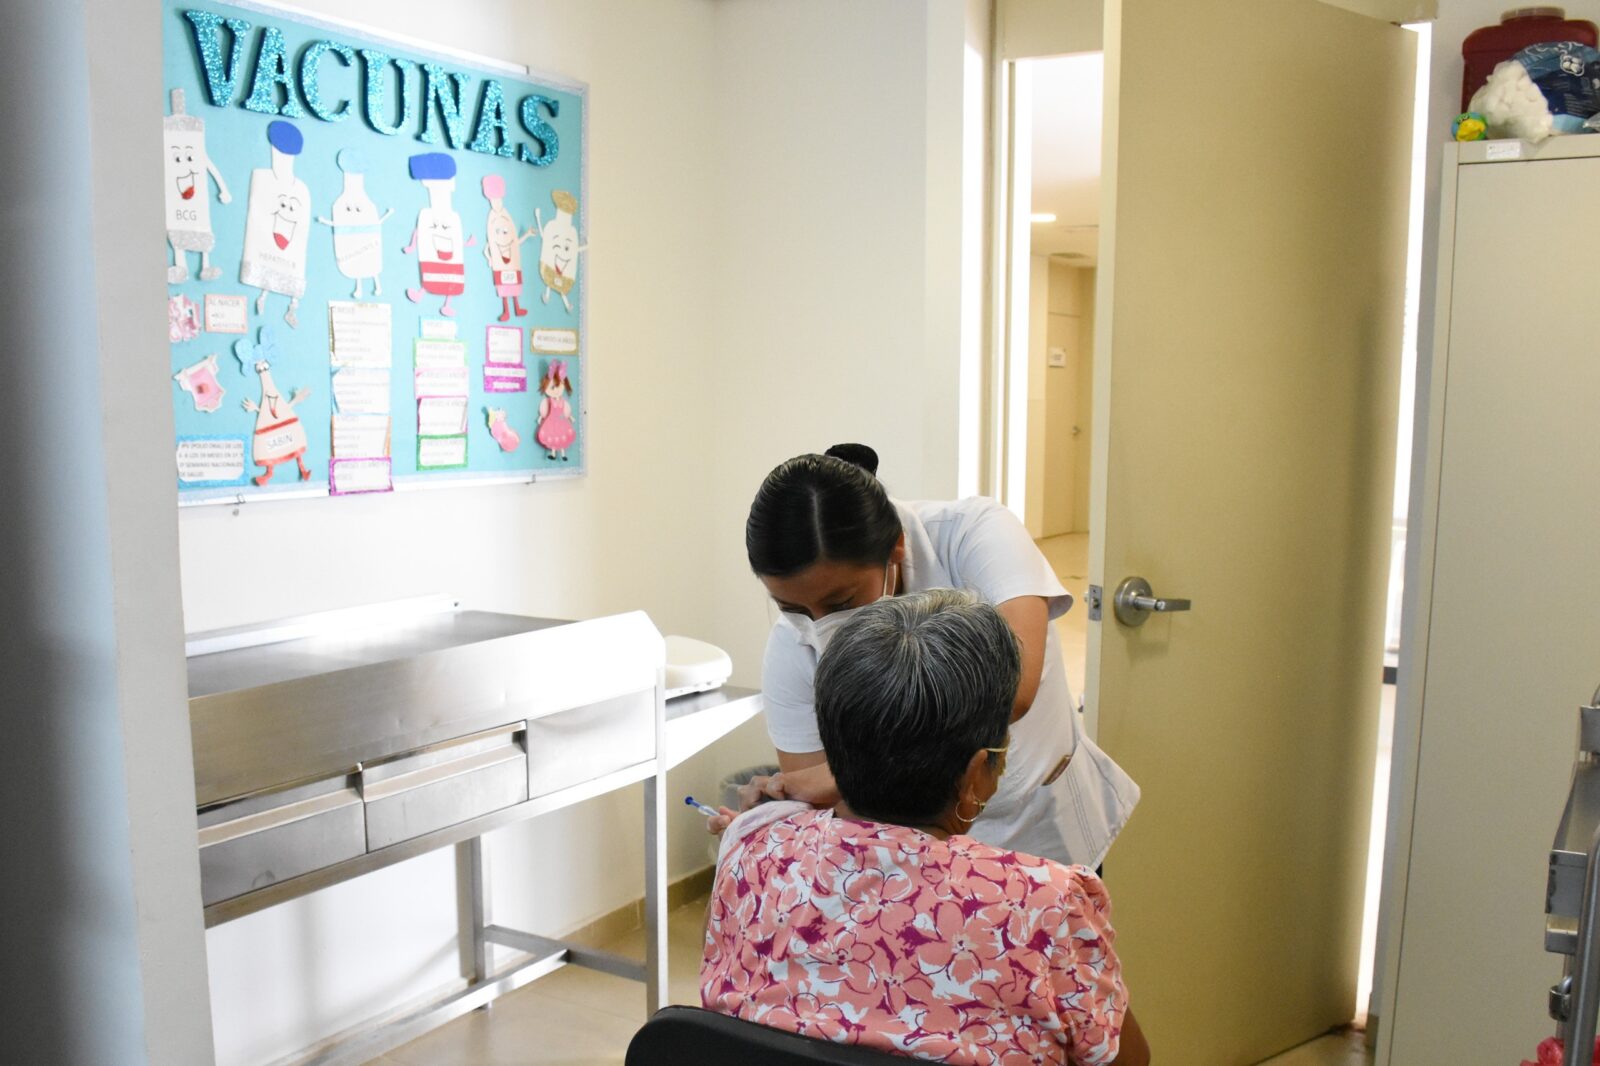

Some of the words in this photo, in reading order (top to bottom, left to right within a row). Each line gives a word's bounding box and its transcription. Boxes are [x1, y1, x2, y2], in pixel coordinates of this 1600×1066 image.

[182, 9, 561, 168] VACUNAS
[176, 209, 197, 221] BCG
[267, 434, 293, 449] SABIN
